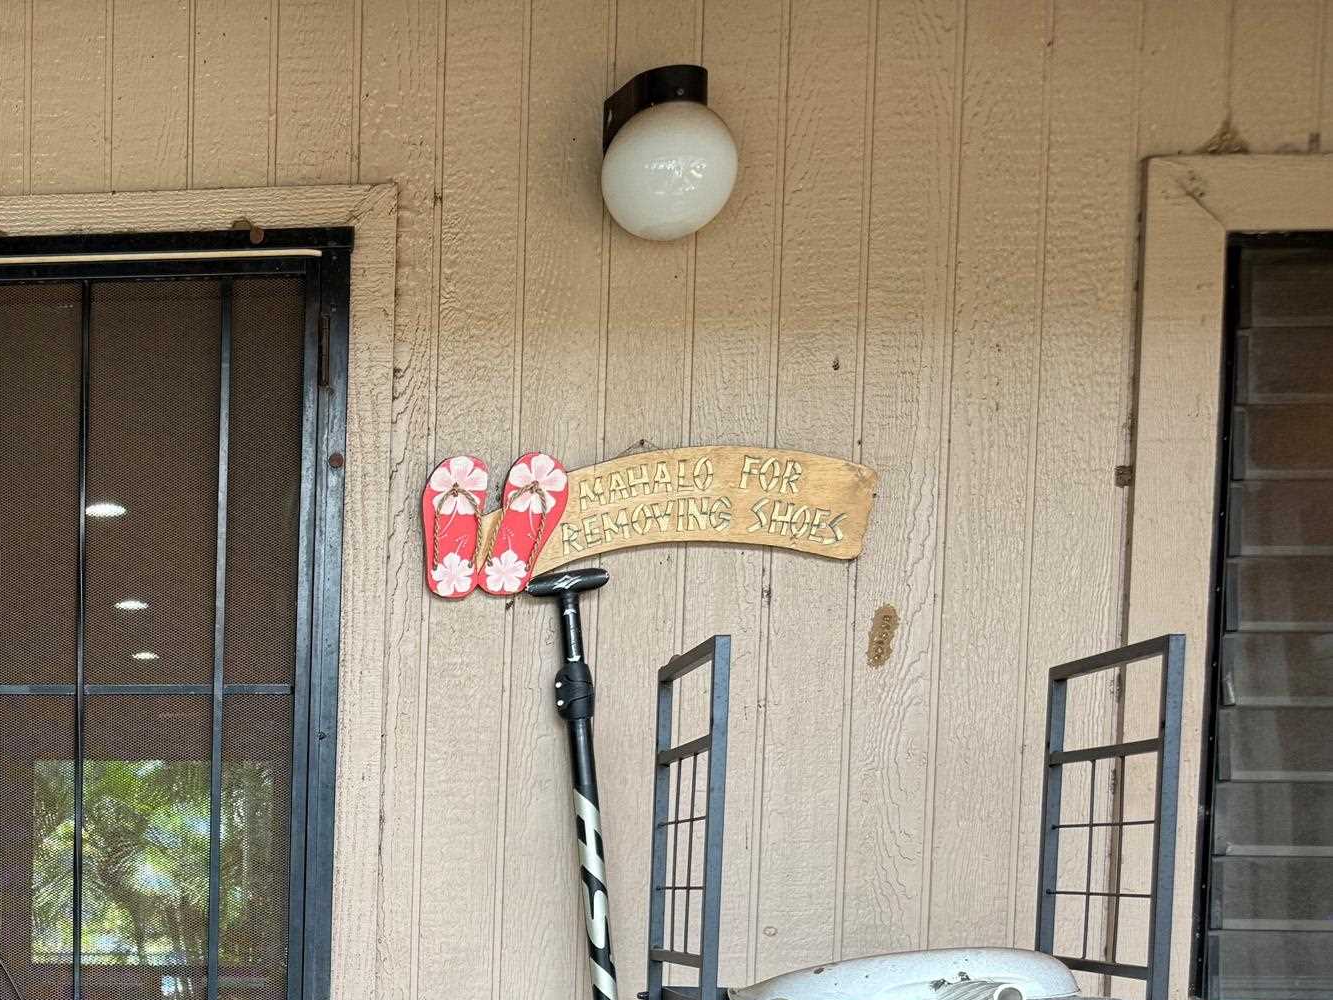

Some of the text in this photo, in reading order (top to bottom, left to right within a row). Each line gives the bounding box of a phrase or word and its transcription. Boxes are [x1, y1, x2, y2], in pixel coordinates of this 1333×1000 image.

[579, 454, 803, 513] MAHALO FOR
[561, 496, 849, 556] REMOVING SHOES
